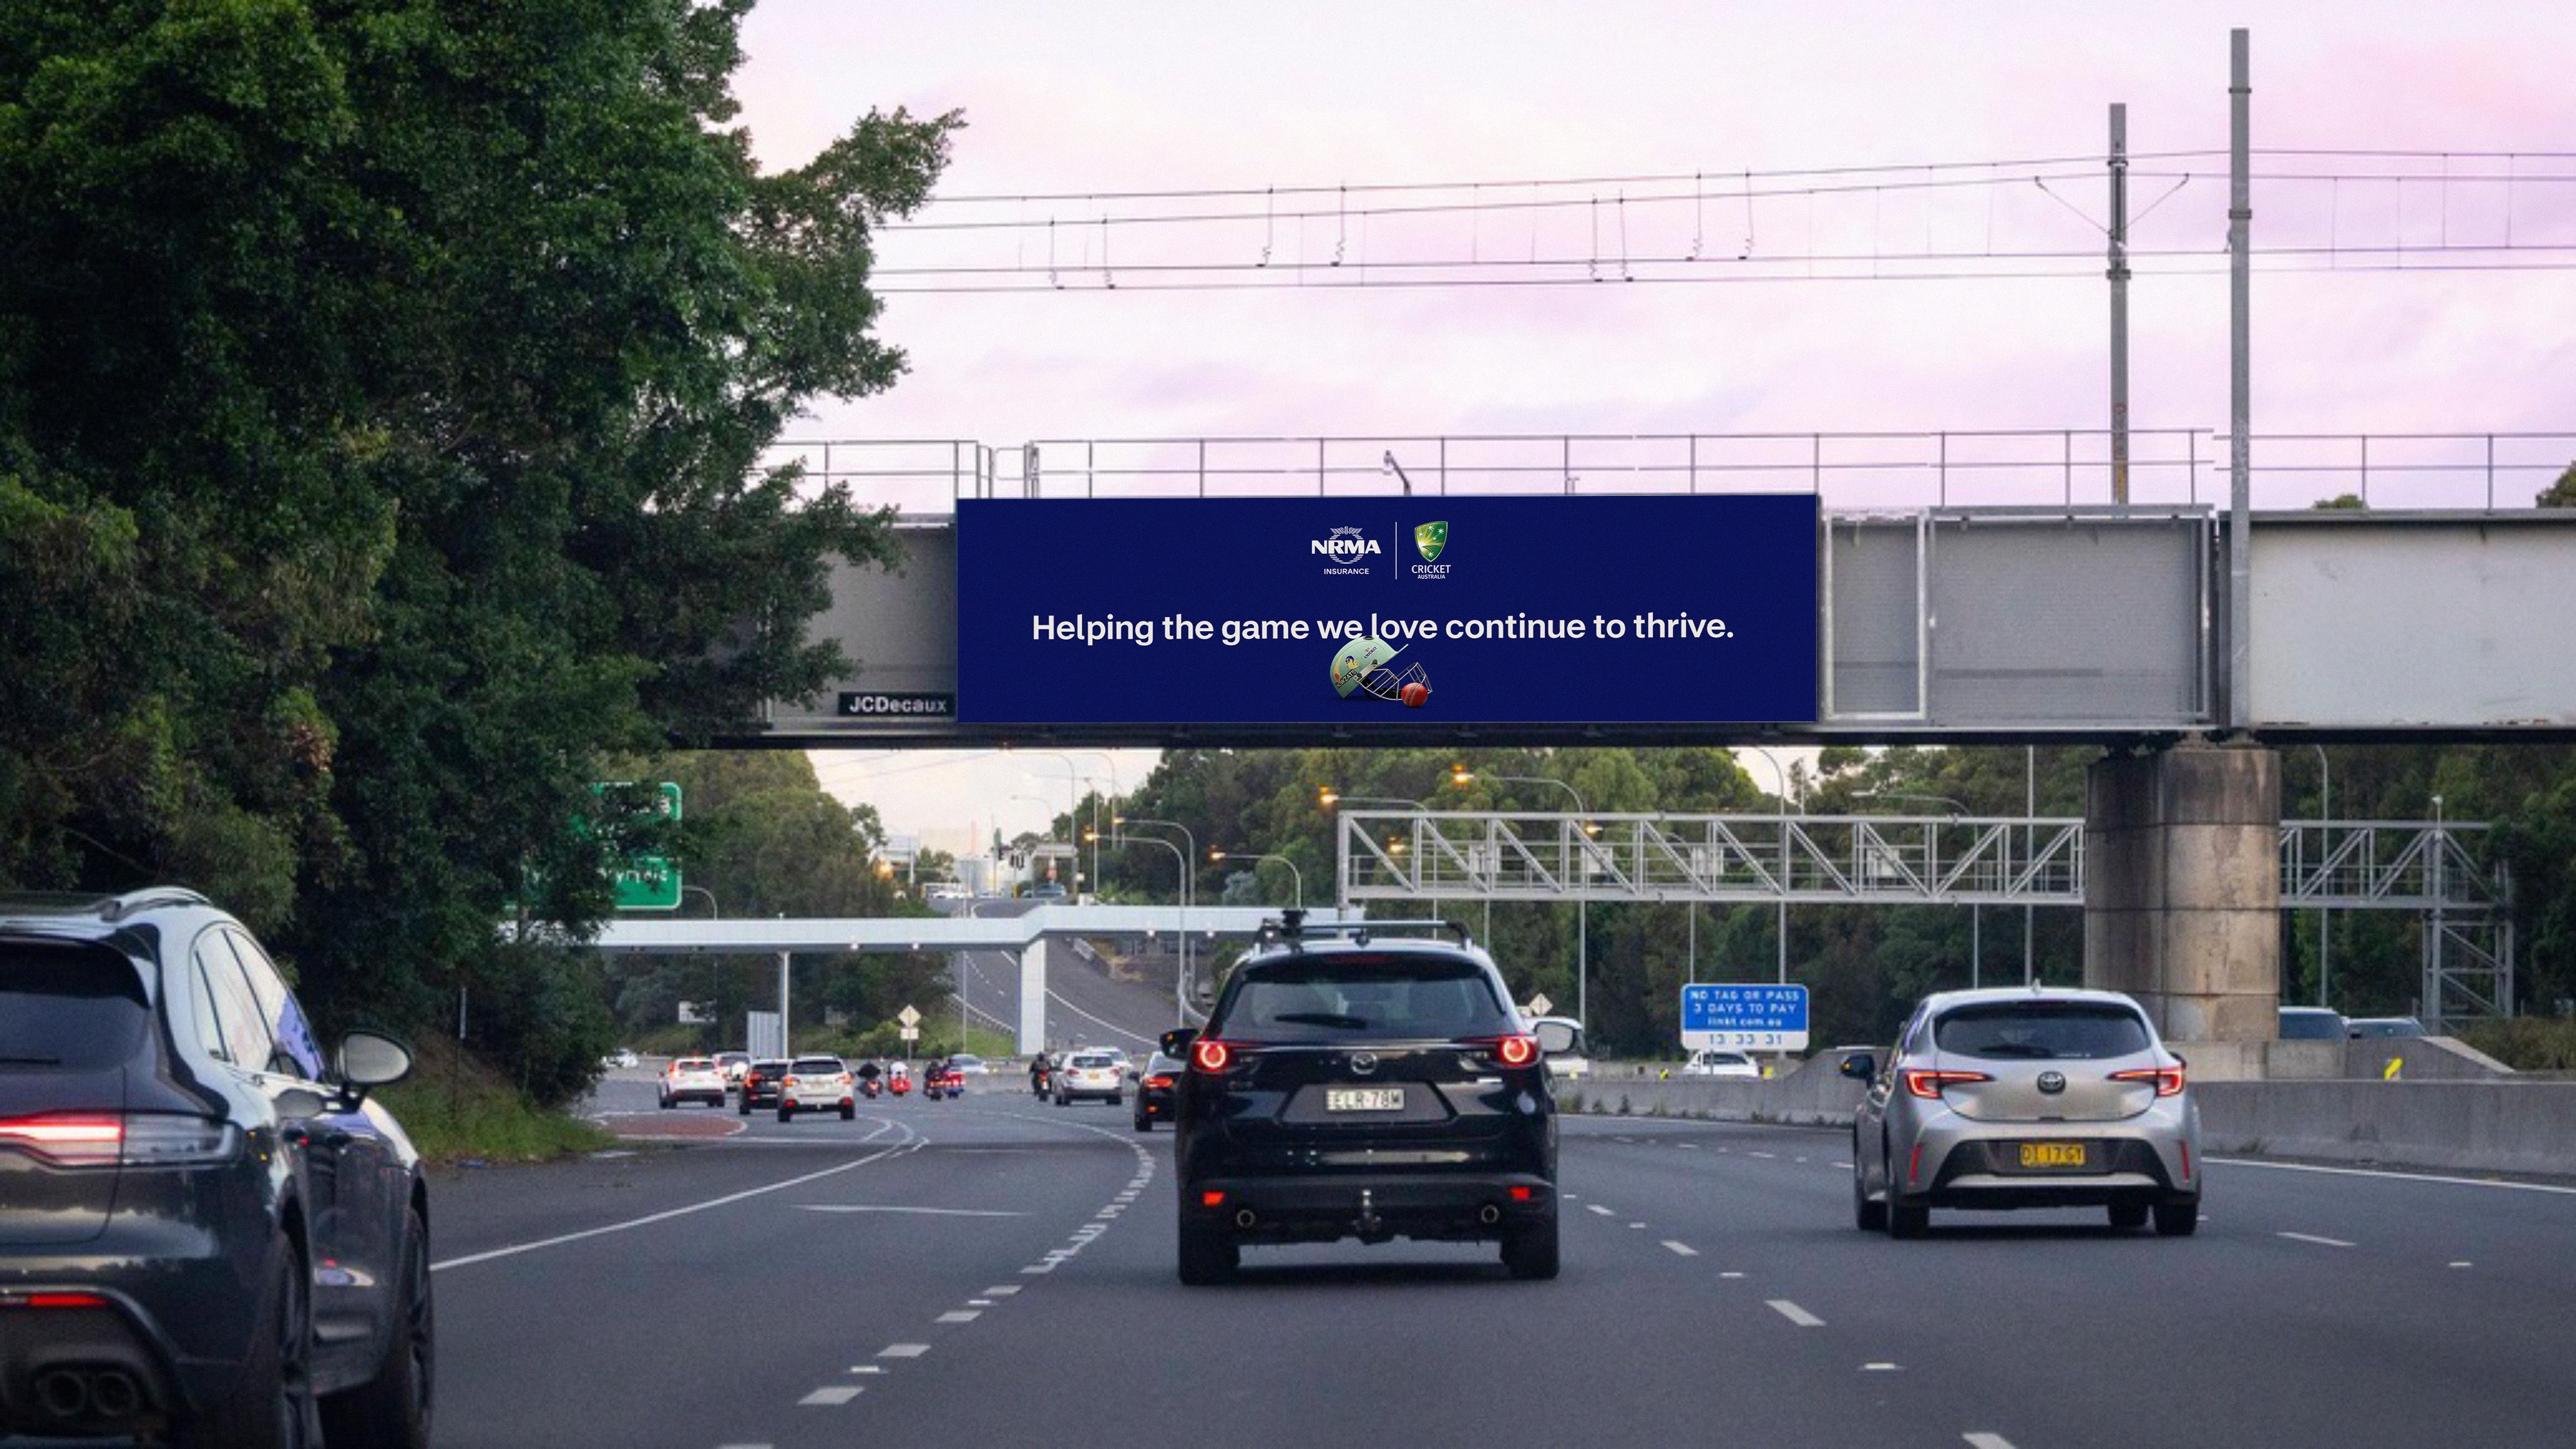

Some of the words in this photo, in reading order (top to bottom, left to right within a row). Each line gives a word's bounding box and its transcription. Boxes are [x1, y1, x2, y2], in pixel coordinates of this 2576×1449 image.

[1311, 540, 1381, 554] NRMA
[1411, 564, 1452, 574] CRICKET
[1033, 613, 1153, 646] Helping
[1162, 613, 1214, 640] the
[1222, 620, 1309, 646] game
[1316, 620, 1363, 639] we
[1371, 612, 1438, 639] love
[1445, 612, 1586, 639] continue
[1593, 615, 1626, 639] to
[1633, 611, 1734, 638] thrive.
[1363, 646, 1378, 659] CRICKET
[849, 696, 947, 713] JCDecaux
[1690, 990, 1708, 999] NO
[1714, 990, 1738, 999] TAG
[1743, 990, 1761, 1000] OR
[1766, 991, 1800, 1001] PASS
[1694, 1003, 1701, 1013] 3
[1708, 1003, 1743, 1013] DAYS
[1748, 1003, 1765, 1013] TO
[1770, 1003, 1797, 1013] PAY
[1709, 1034, 1725, 1045] 13
[1736, 1034, 1756, 1045] 33
[1765, 1034, 1783, 1045] 31
